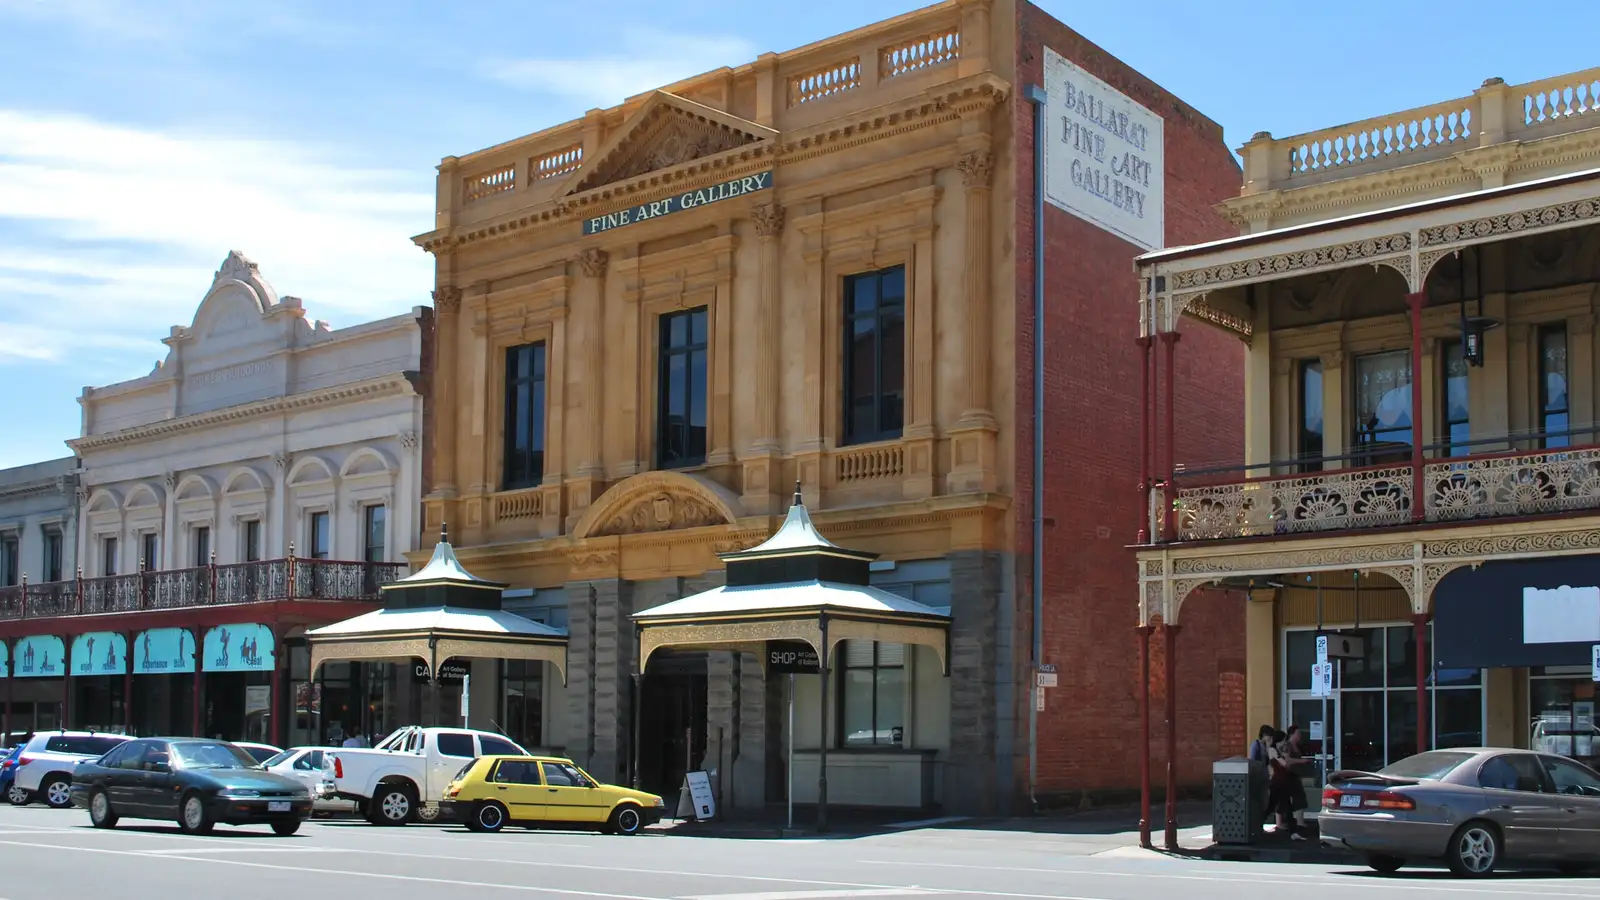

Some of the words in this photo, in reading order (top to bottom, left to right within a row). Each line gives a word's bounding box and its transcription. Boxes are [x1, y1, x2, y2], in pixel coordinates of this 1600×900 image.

[1064, 80, 1148, 151] BALLARAT
[1061, 116, 1106, 164] FINE
[1111, 152, 1152, 188] ART
[590, 210, 630, 233] FINE
[636, 198, 673, 222] ART
[680, 172, 768, 210] GALLERY
[1070, 159, 1146, 219] GALLERY
[771, 651, 796, 664] SHOP
